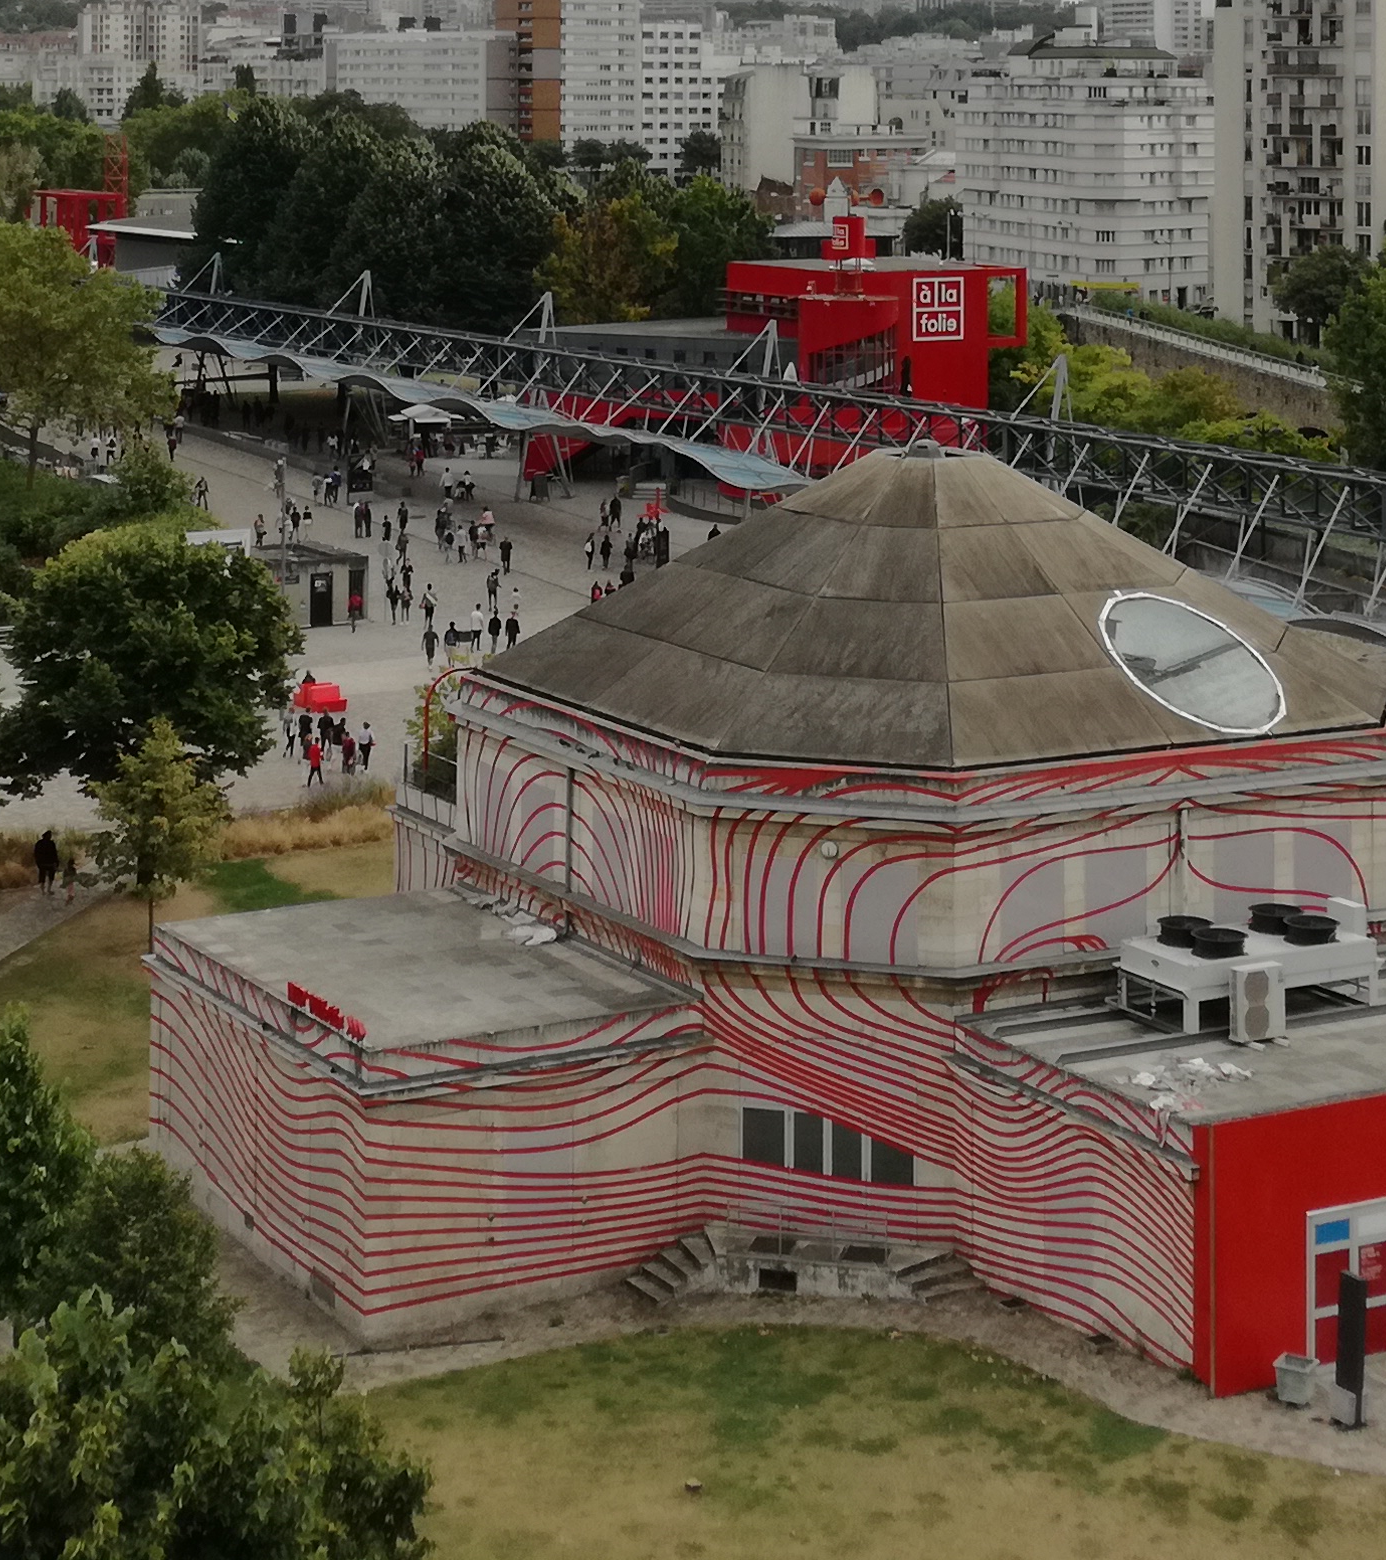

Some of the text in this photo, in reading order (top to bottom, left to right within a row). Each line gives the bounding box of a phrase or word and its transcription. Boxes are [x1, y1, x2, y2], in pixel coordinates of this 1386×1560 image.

[920, 284, 957, 303] à la
[920, 313, 957, 333] folie
